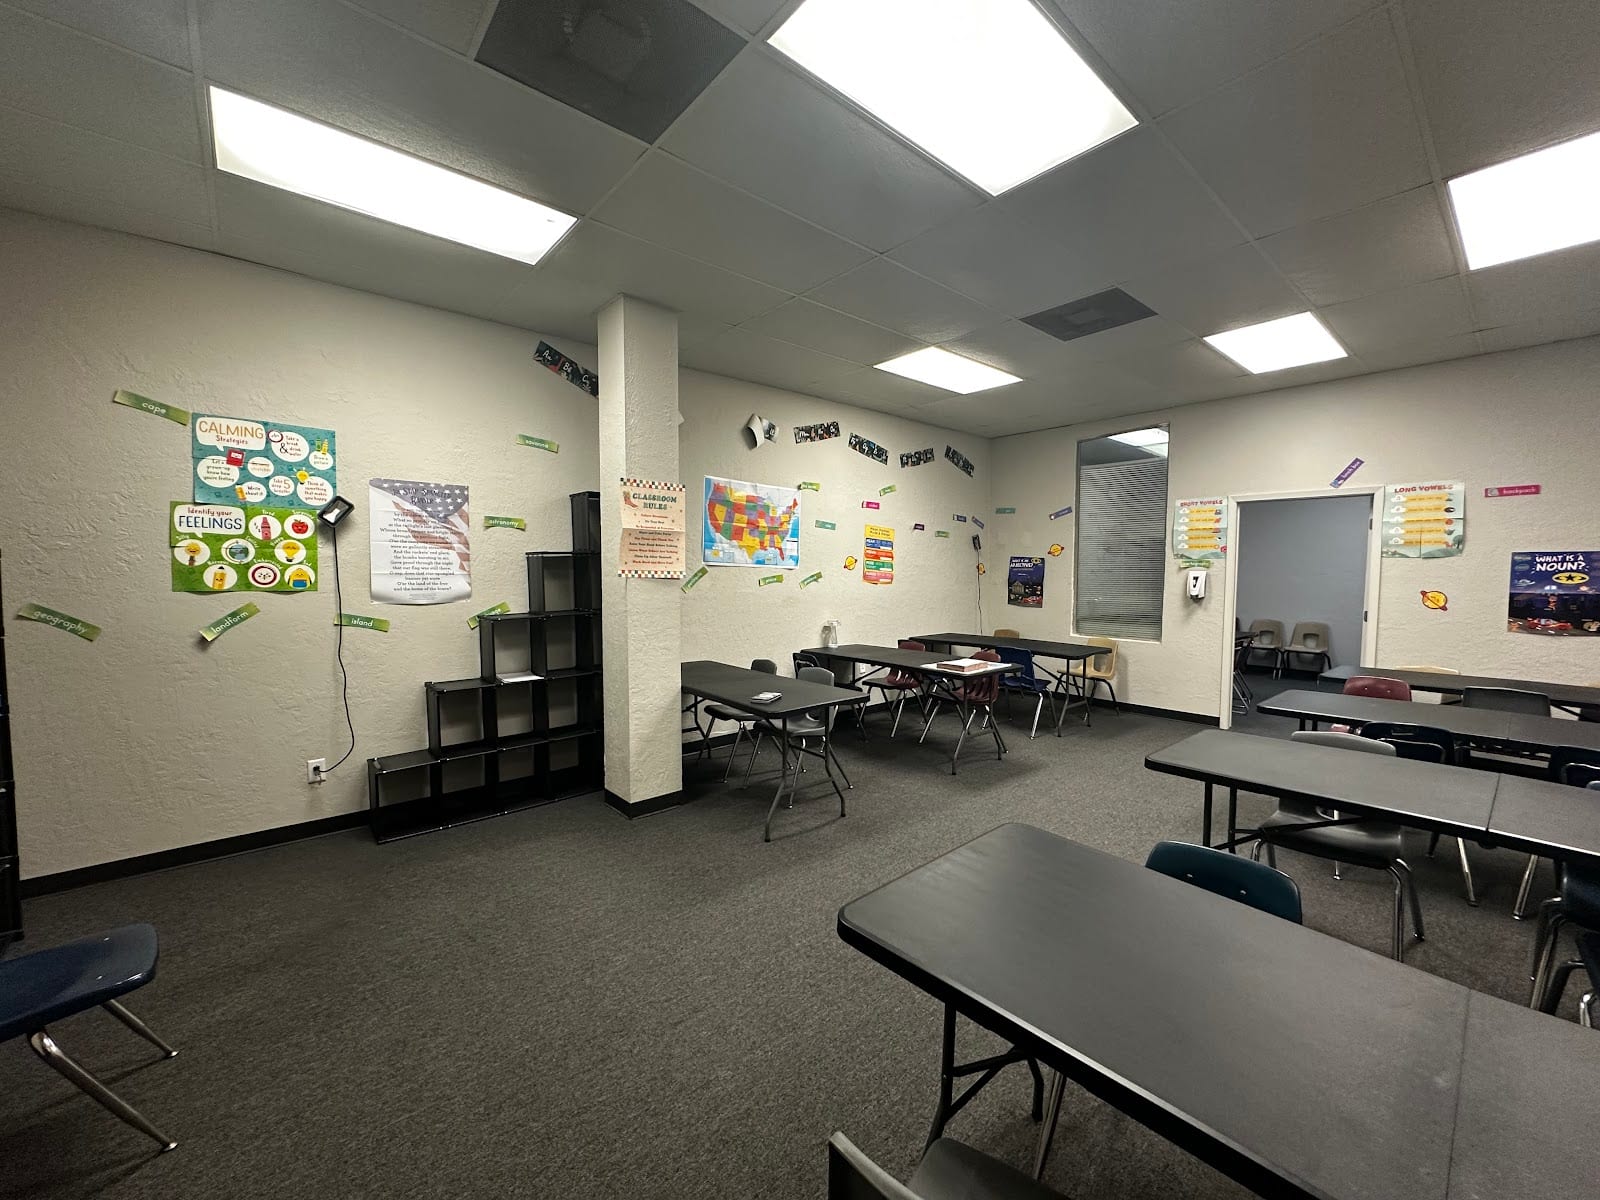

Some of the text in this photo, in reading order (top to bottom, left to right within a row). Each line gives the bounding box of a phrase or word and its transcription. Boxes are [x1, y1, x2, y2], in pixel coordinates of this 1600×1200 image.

[142, 400, 167, 415] cape
[199, 420, 264, 439] CALMING
[216, 435, 248, 446] Strategies
[284, 480, 291, 489] 5
[632, 493, 677, 503] CLASSROOM
[643, 502, 668, 510] RULES
[188, 507, 215, 516] Identify
[179, 515, 243, 530] FEELINGS
[489, 520, 519, 528] astronomy
[1536, 562, 1586, 571] NOUN?
[33, 610, 87, 635] geography
[212, 610, 249, 634] landform
[352, 618, 373, 628] island
